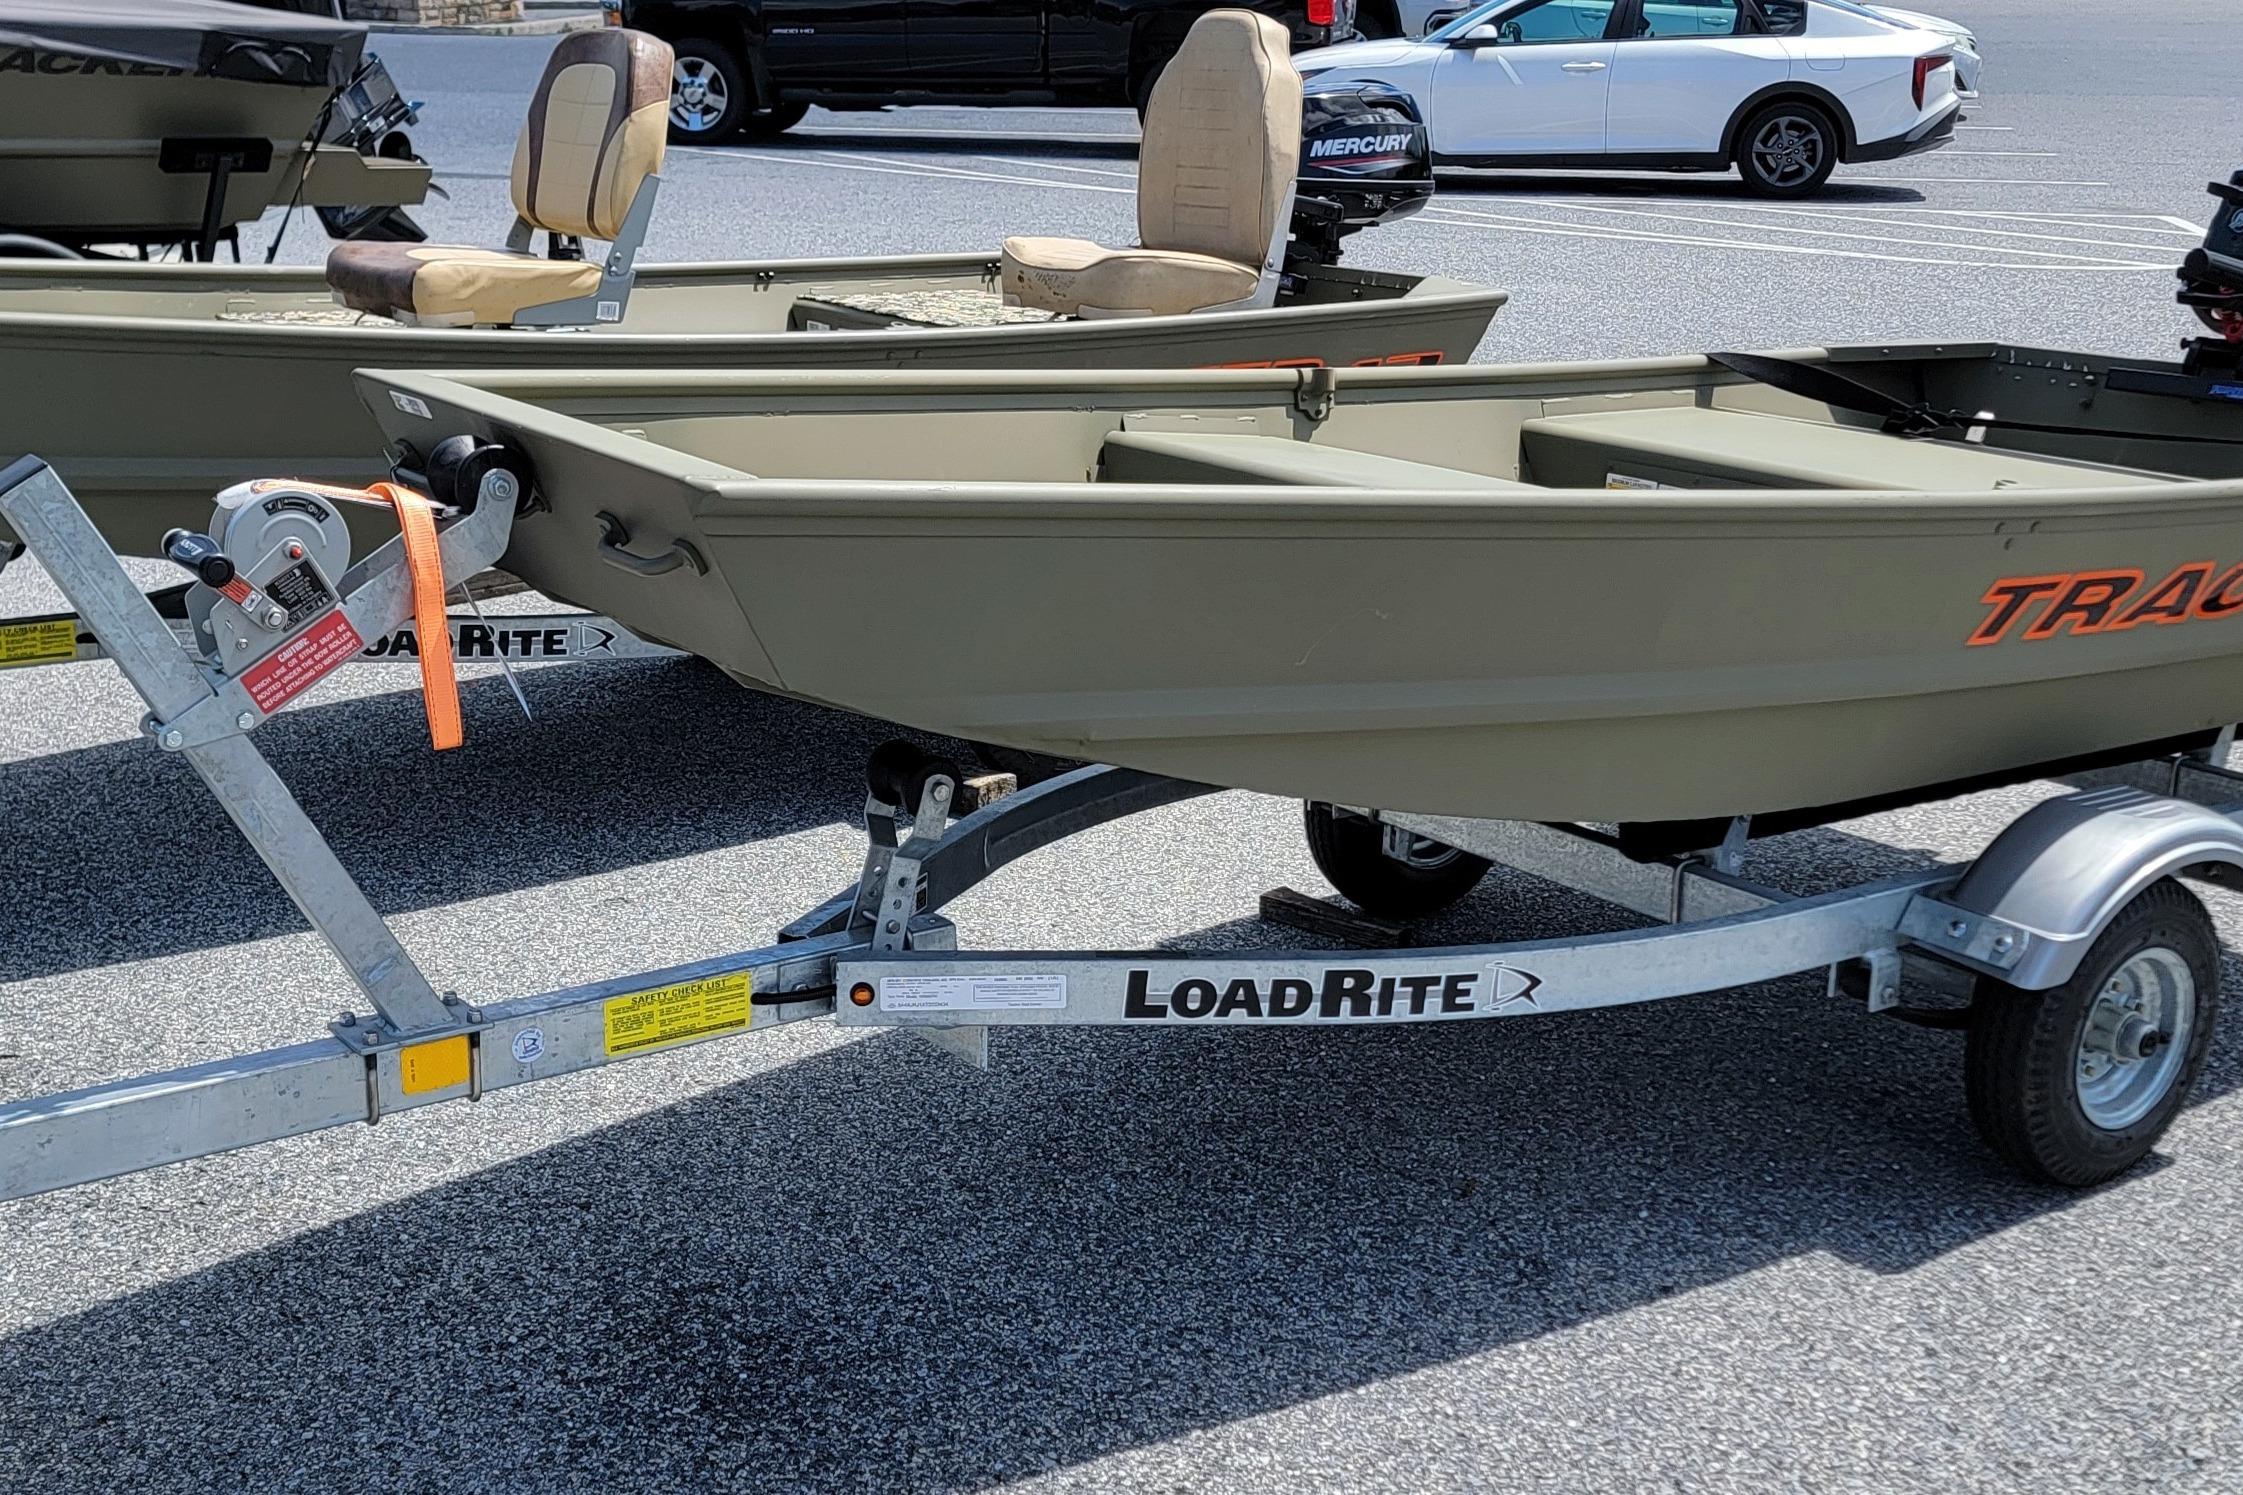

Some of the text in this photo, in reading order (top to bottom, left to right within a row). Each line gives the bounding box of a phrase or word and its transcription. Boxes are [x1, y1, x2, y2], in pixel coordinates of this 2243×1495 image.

[1309, 133, 1413, 158] MERCURY
[251, 623, 348, 693] WINCH LINE OR STRAP MUST BE
[256, 682, 282, 701] ROUTED
[281, 666, 303, 684] UNDER
[301, 658, 315, 671] THE
[313, 648, 329, 661] BOW
[328, 631, 353, 650] ROLLER
[262, 690, 286, 709] BEFORE
[285, 669, 316, 693] ATTACHING
[315, 663, 324, 672] TO
[322, 639, 357, 666] WATERCRAFT
[631, 979, 728, 1005] SAFETY CHECK LIST
[1123, 968, 1480, 1020] LOADRITE
